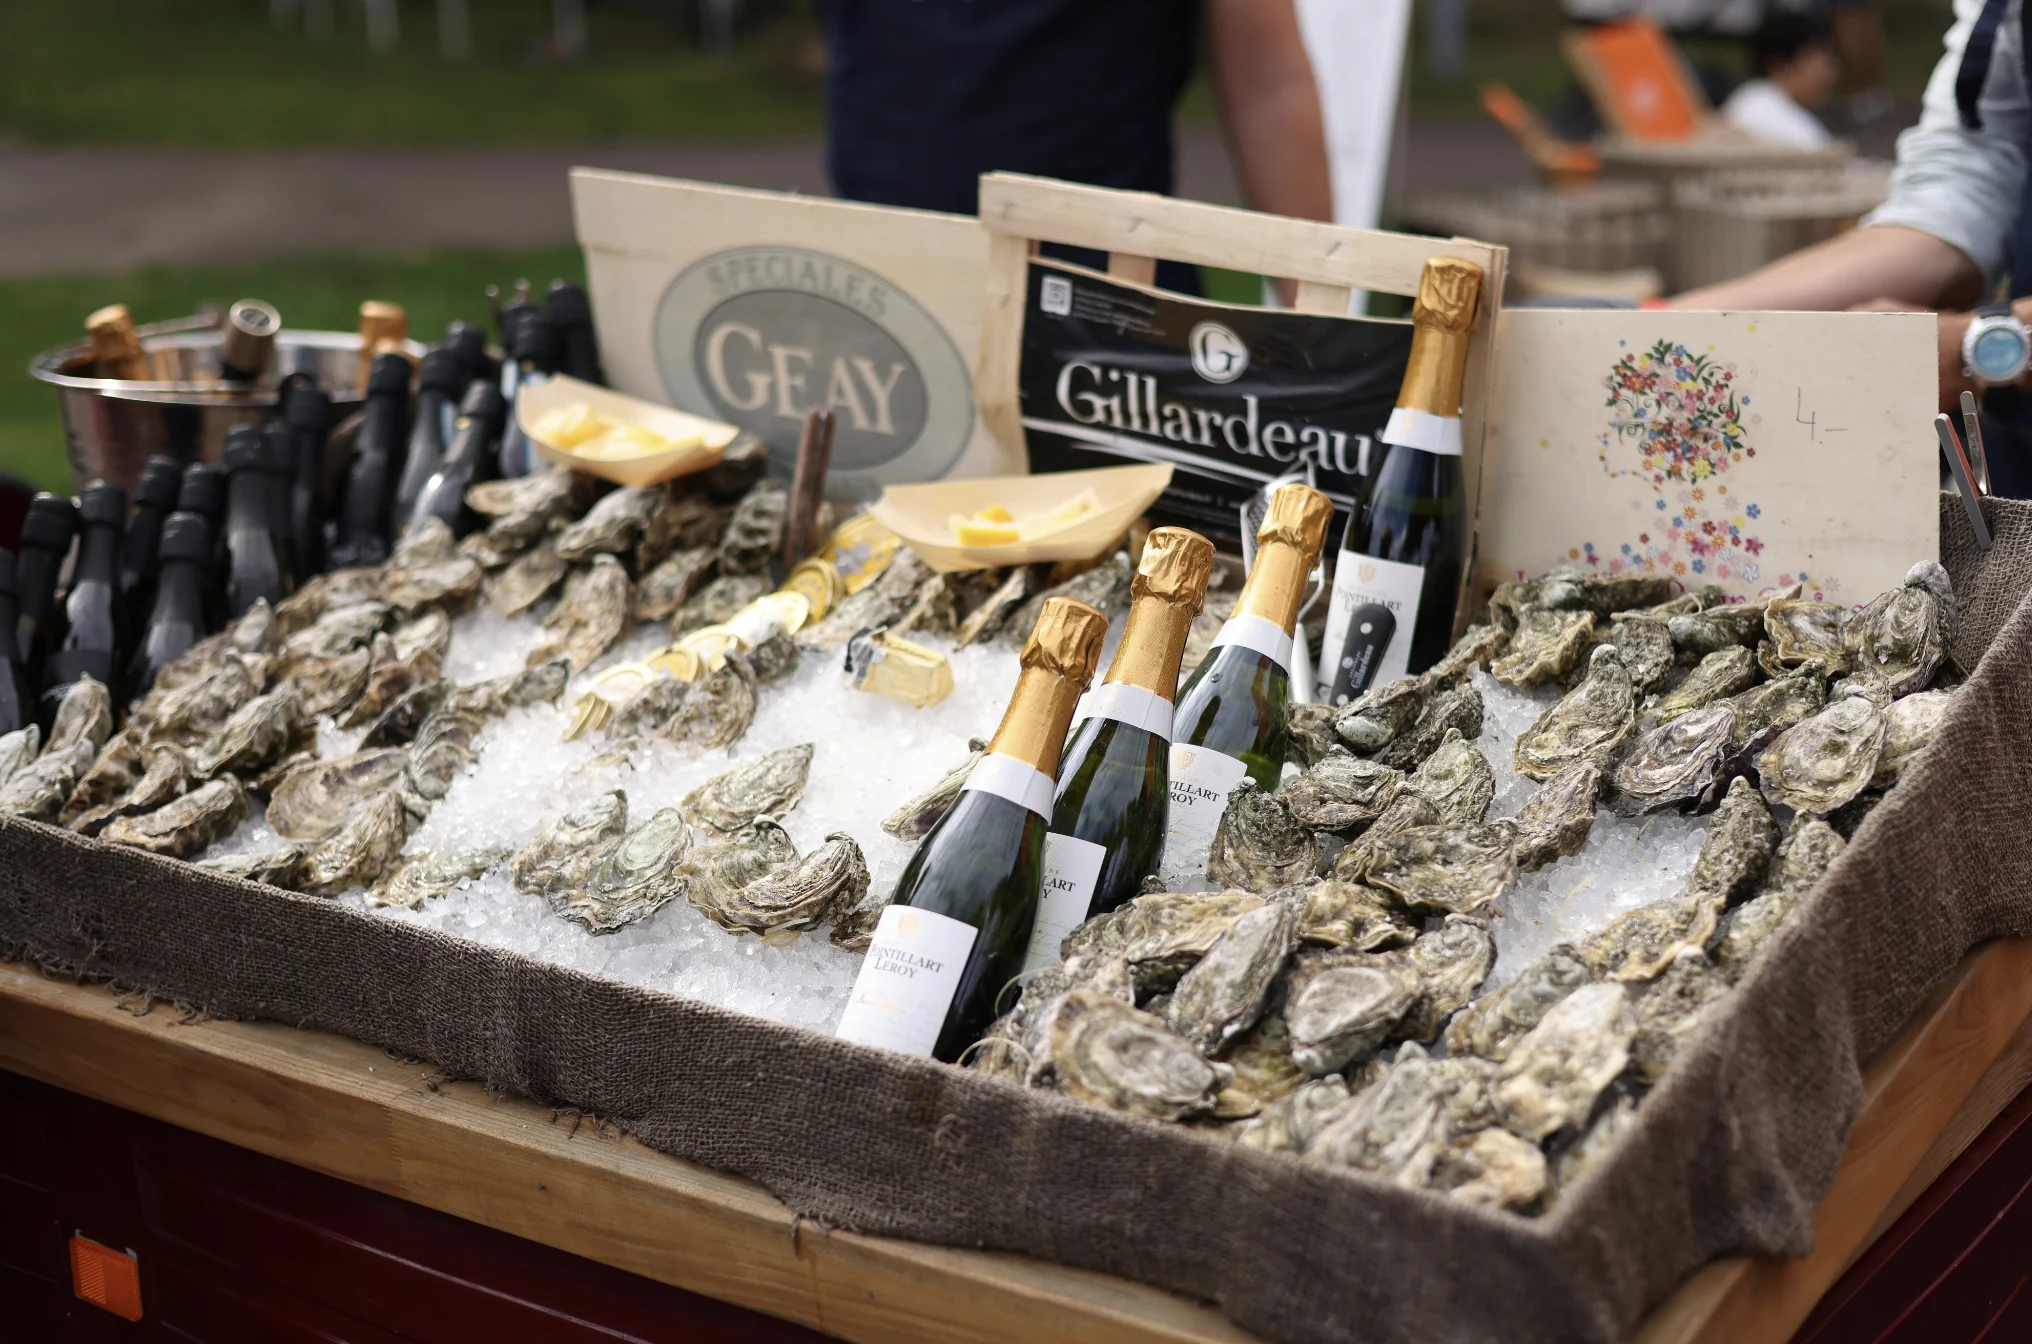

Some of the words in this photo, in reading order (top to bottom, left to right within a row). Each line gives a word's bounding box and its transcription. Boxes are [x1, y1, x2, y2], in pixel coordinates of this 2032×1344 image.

[706, 256, 888, 318] SPECIALES
[705, 321, 906, 436] GEAY
[1055, 360, 1373, 476] Gillardeau
[874, 957, 919, 978] LEROY
